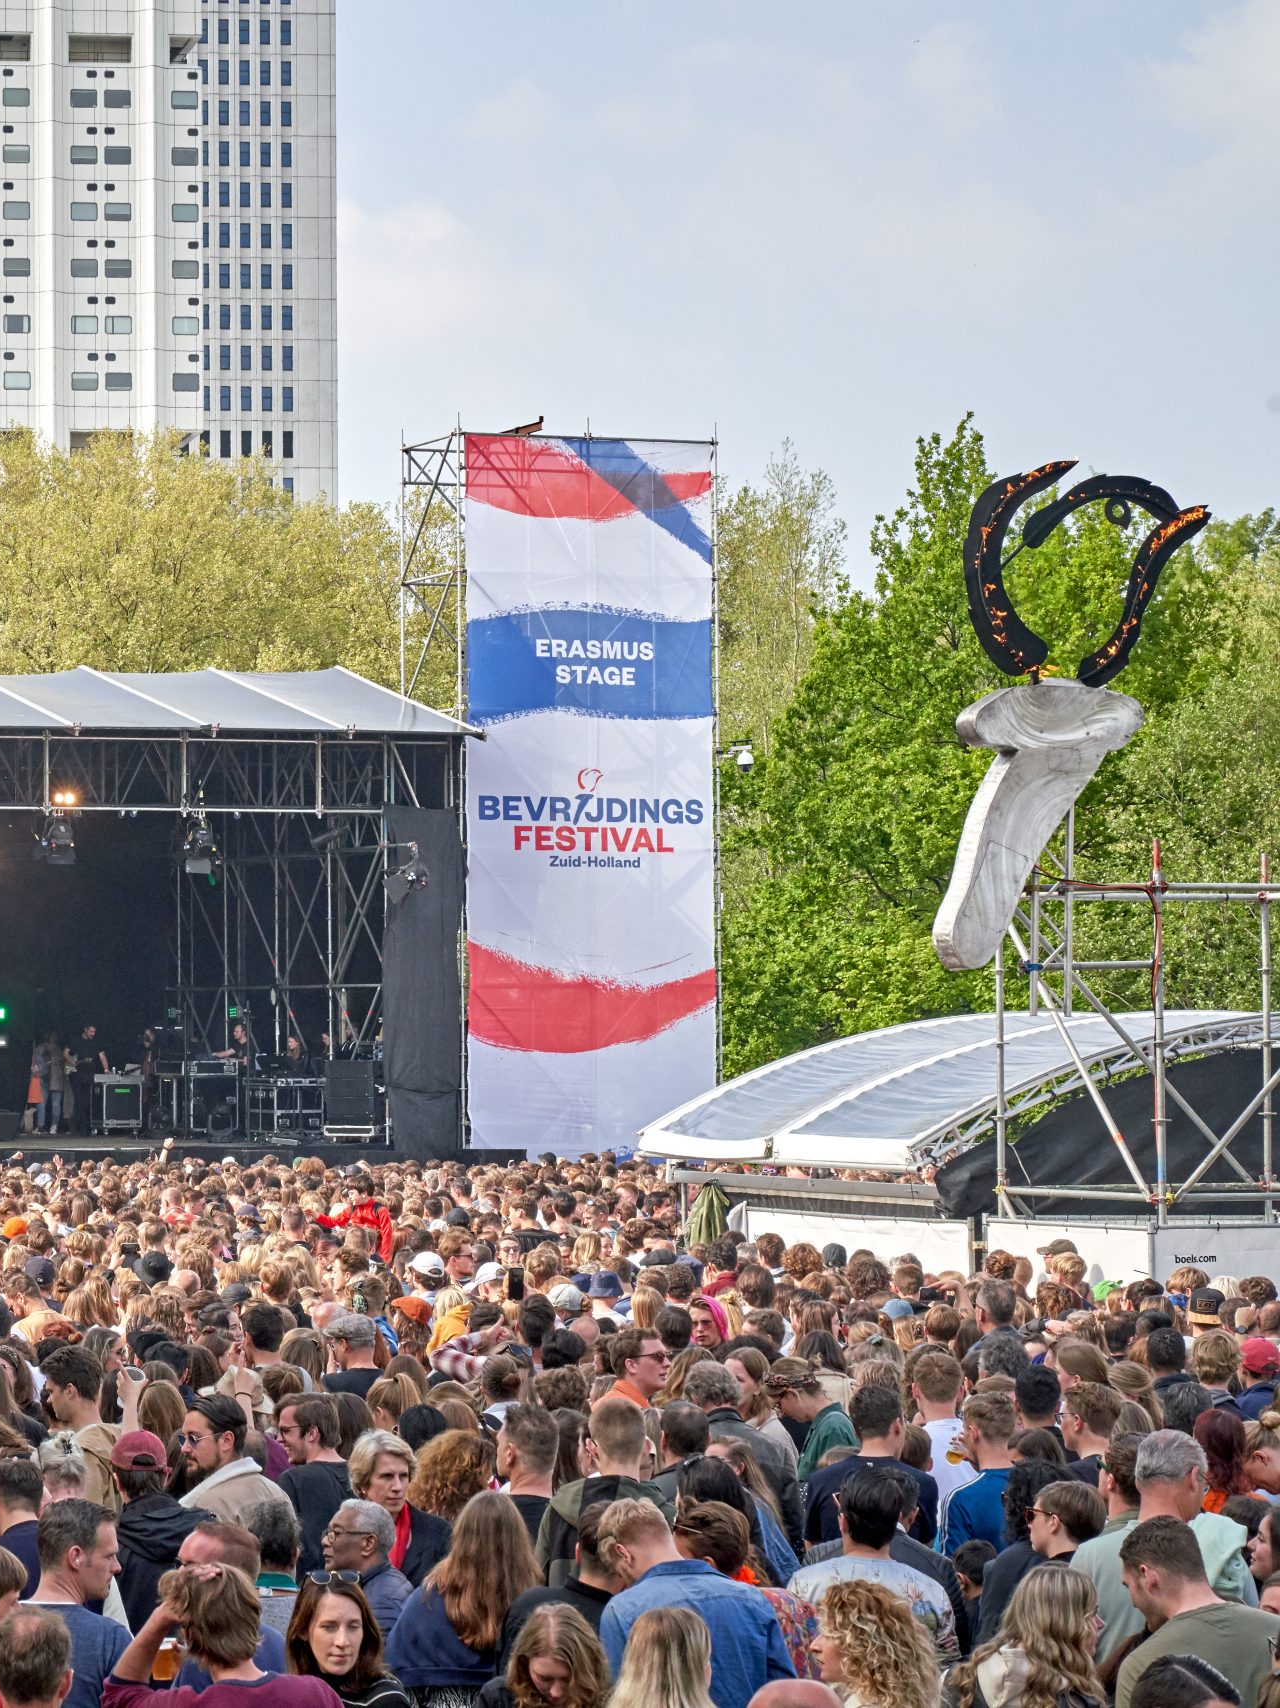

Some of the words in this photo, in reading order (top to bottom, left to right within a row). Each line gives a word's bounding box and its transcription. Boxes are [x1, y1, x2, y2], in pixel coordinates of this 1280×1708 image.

[535, 639, 654, 661] ERASMUS
[555, 665, 636, 686] STAGE
[478, 793, 704, 826] BEVRIJDINGS
[513, 826, 675, 853] FESTIVAL
[549, 856, 641, 869] Zuid-Holland
[1174, 1254, 1217, 1264] boels.com
